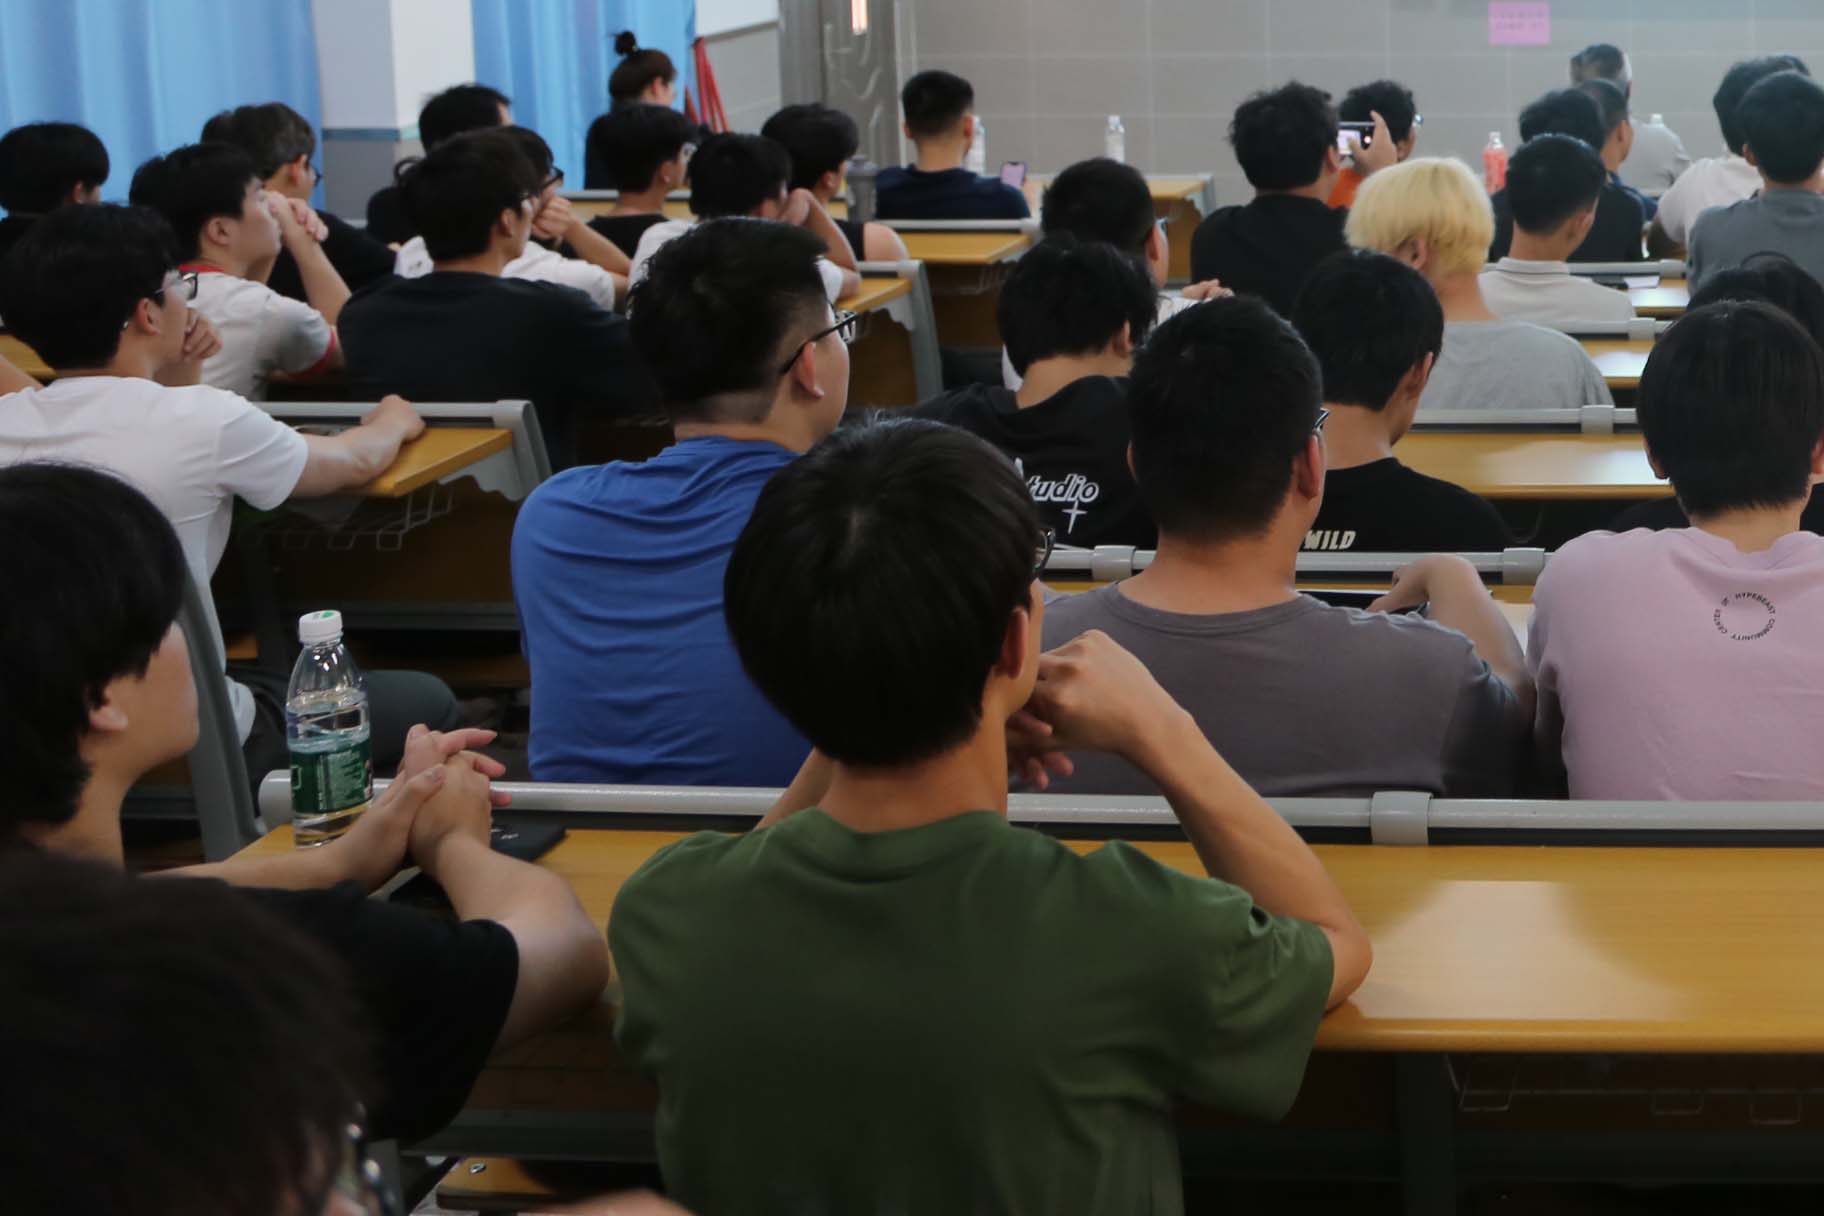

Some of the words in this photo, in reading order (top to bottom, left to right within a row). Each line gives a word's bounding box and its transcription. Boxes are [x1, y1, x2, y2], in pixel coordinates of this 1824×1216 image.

[1025, 473, 1100, 503] tudio
[1303, 530, 1357, 550] WILD
[1735, 592, 1776, 615] HYPEBEAST
